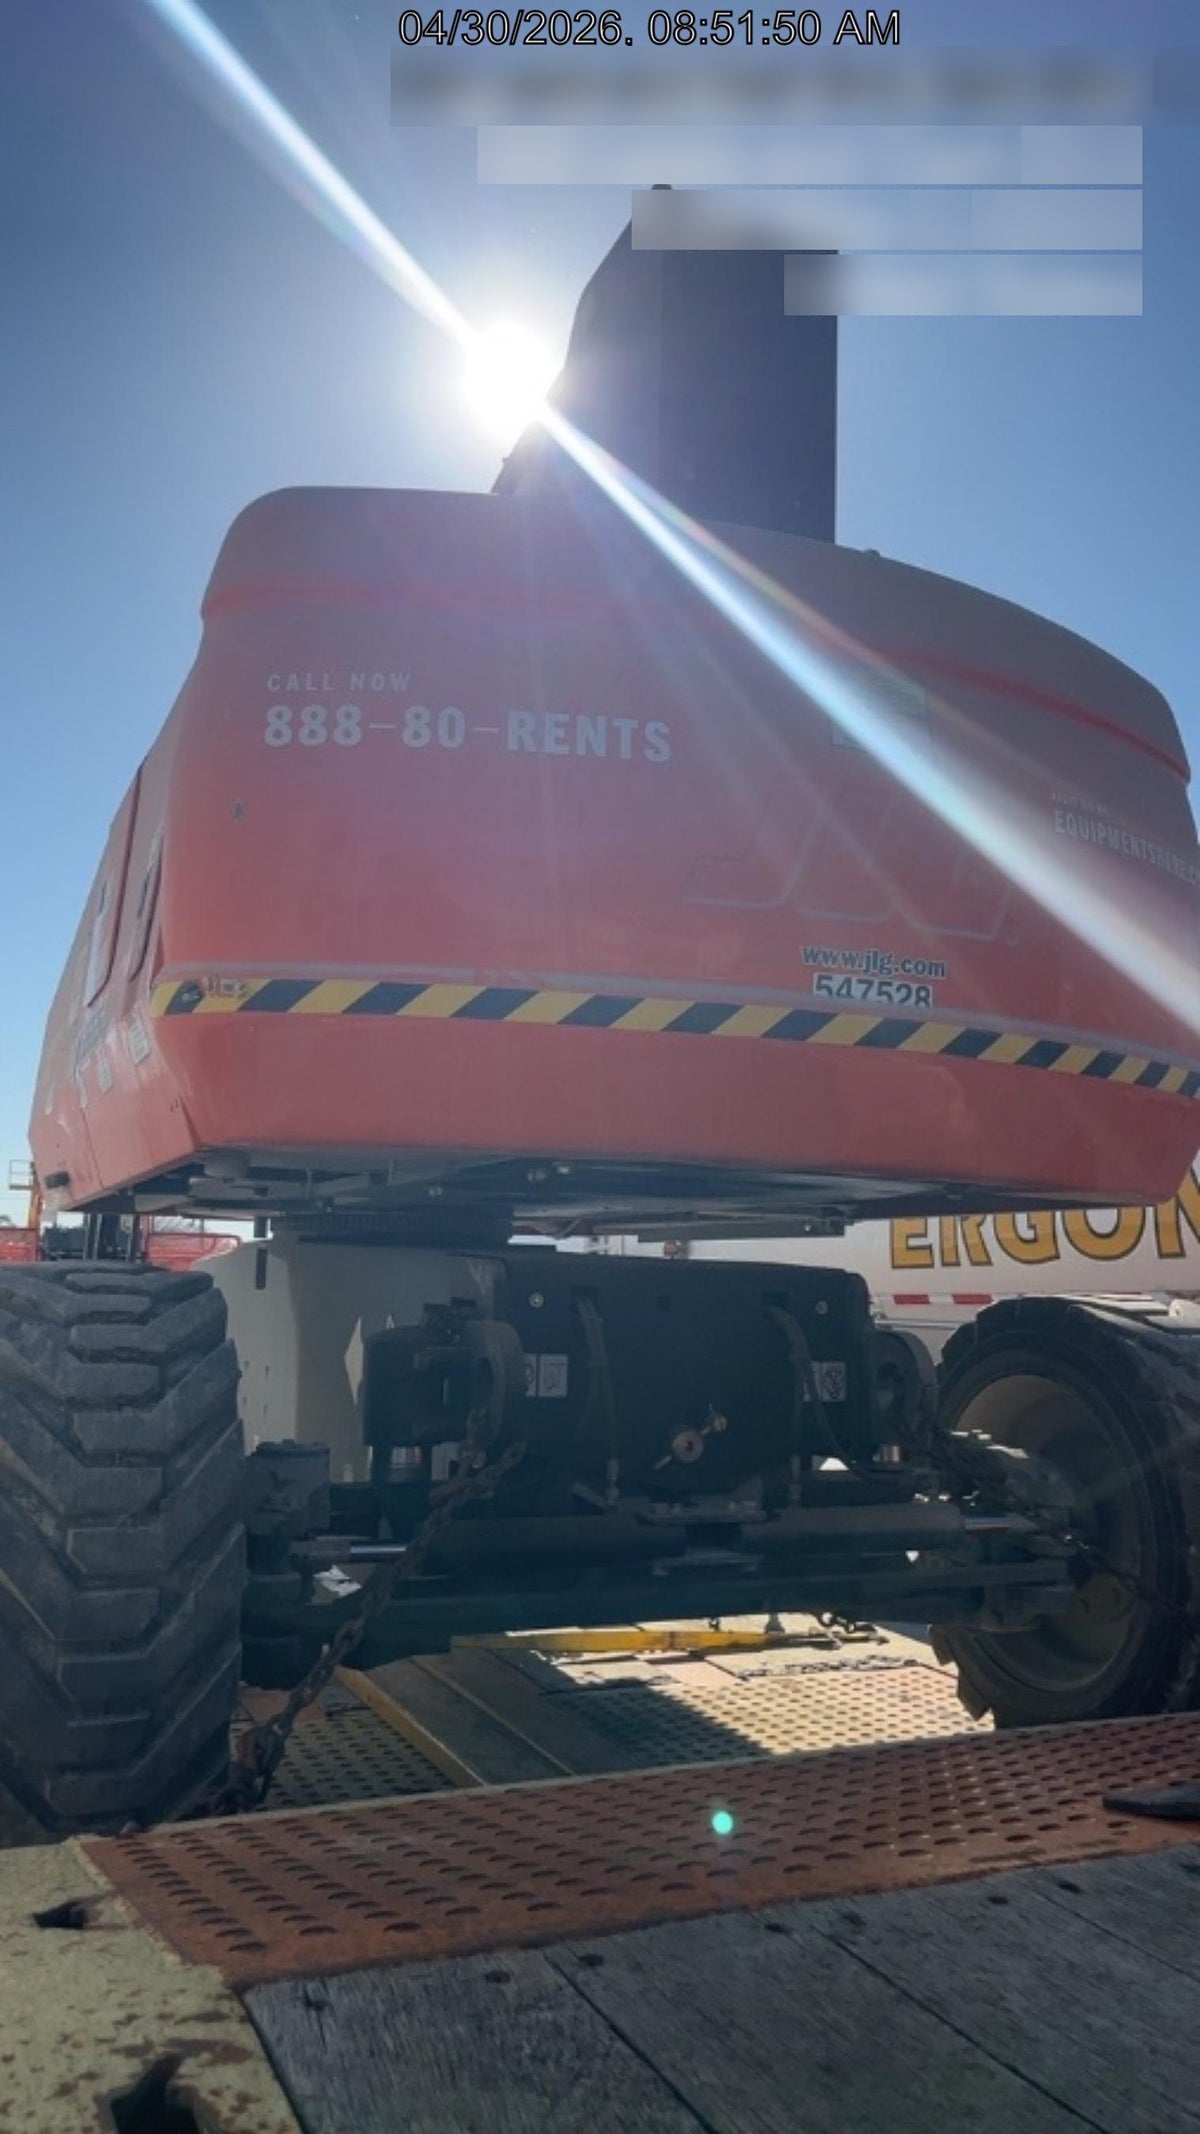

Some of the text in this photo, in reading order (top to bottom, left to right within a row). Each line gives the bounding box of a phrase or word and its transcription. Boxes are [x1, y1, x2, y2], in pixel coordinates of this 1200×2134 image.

[266, 672, 411, 692] CALL NOW
[264, 704, 671, 762] 888-80-RENTS
[802, 947, 946, 978] www.jlg.com
[815, 973, 931, 1008] 547528
